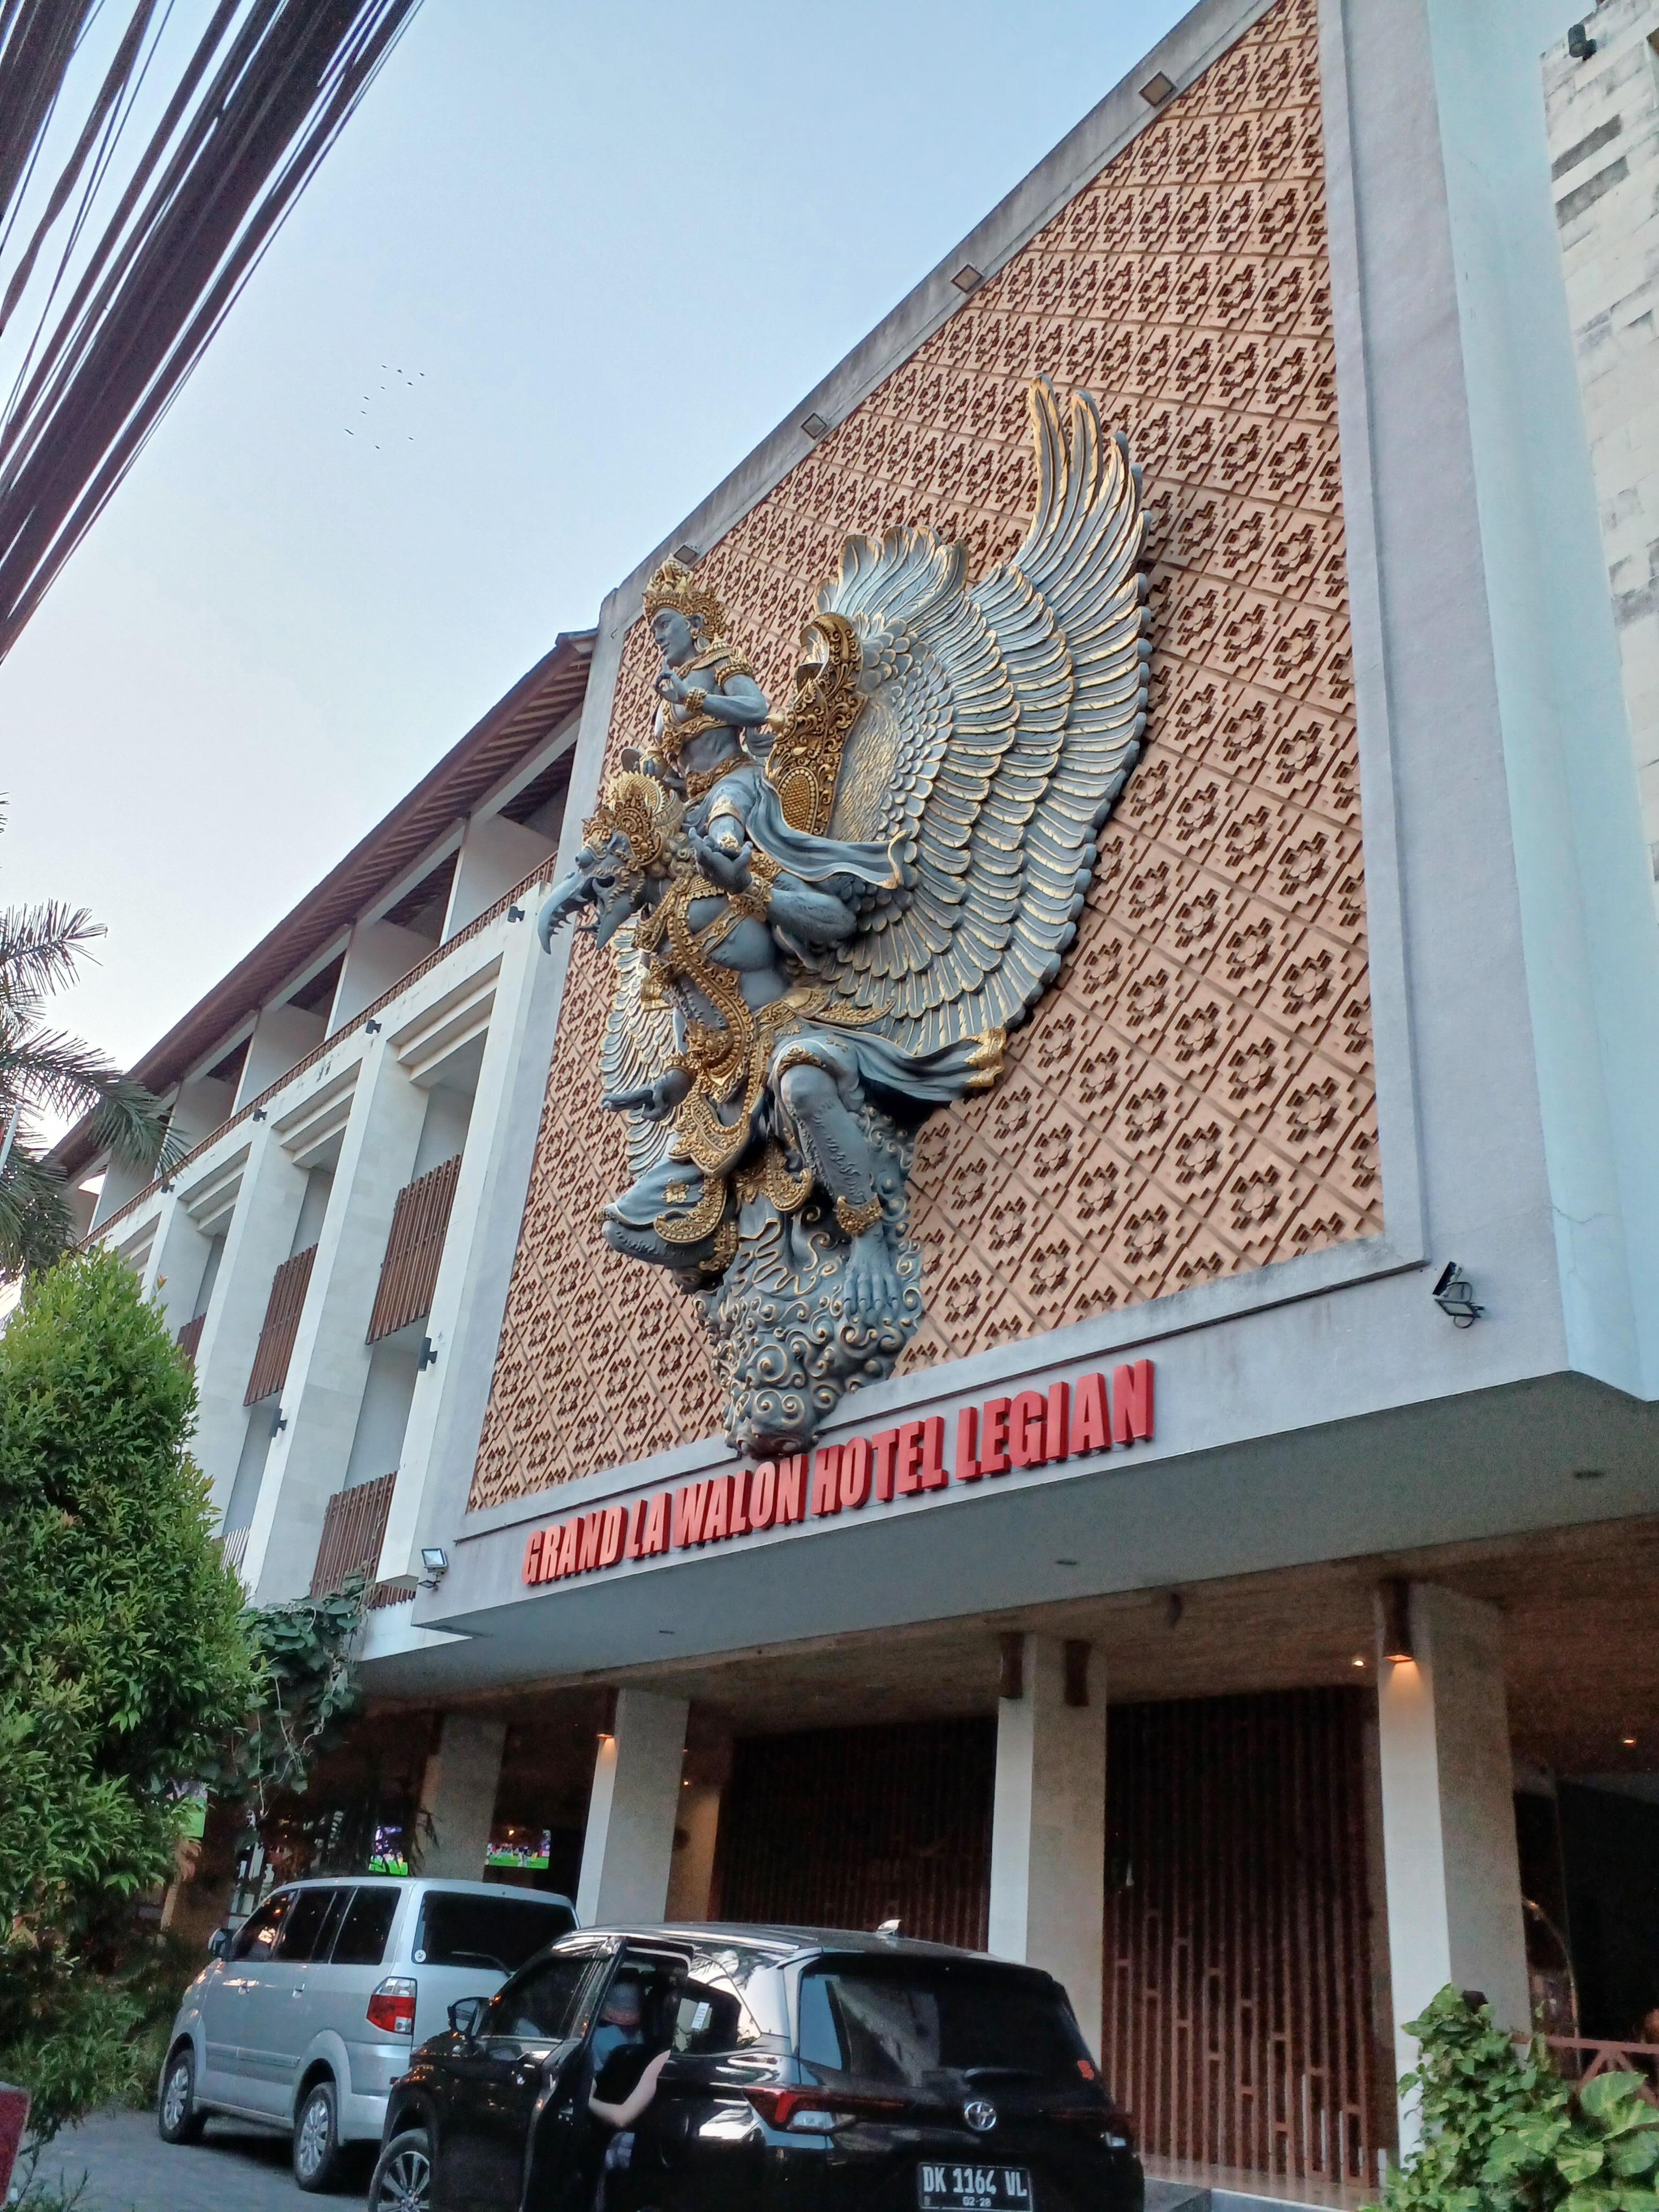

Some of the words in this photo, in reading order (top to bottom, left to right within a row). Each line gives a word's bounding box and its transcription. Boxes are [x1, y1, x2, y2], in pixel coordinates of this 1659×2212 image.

[522, 1506, 628, 1585] GRAND
[625, 1492, 672, 1560] LA
[673, 1454, 809, 1548] WALON
[812, 1416, 948, 1517] HOTEL
[956, 1359, 1154, 1482] LEGIAN
[922, 2166, 946, 2192] DK
[953, 2168, 997, 2194] 1164
[1005, 2171, 1027, 2196] VL
